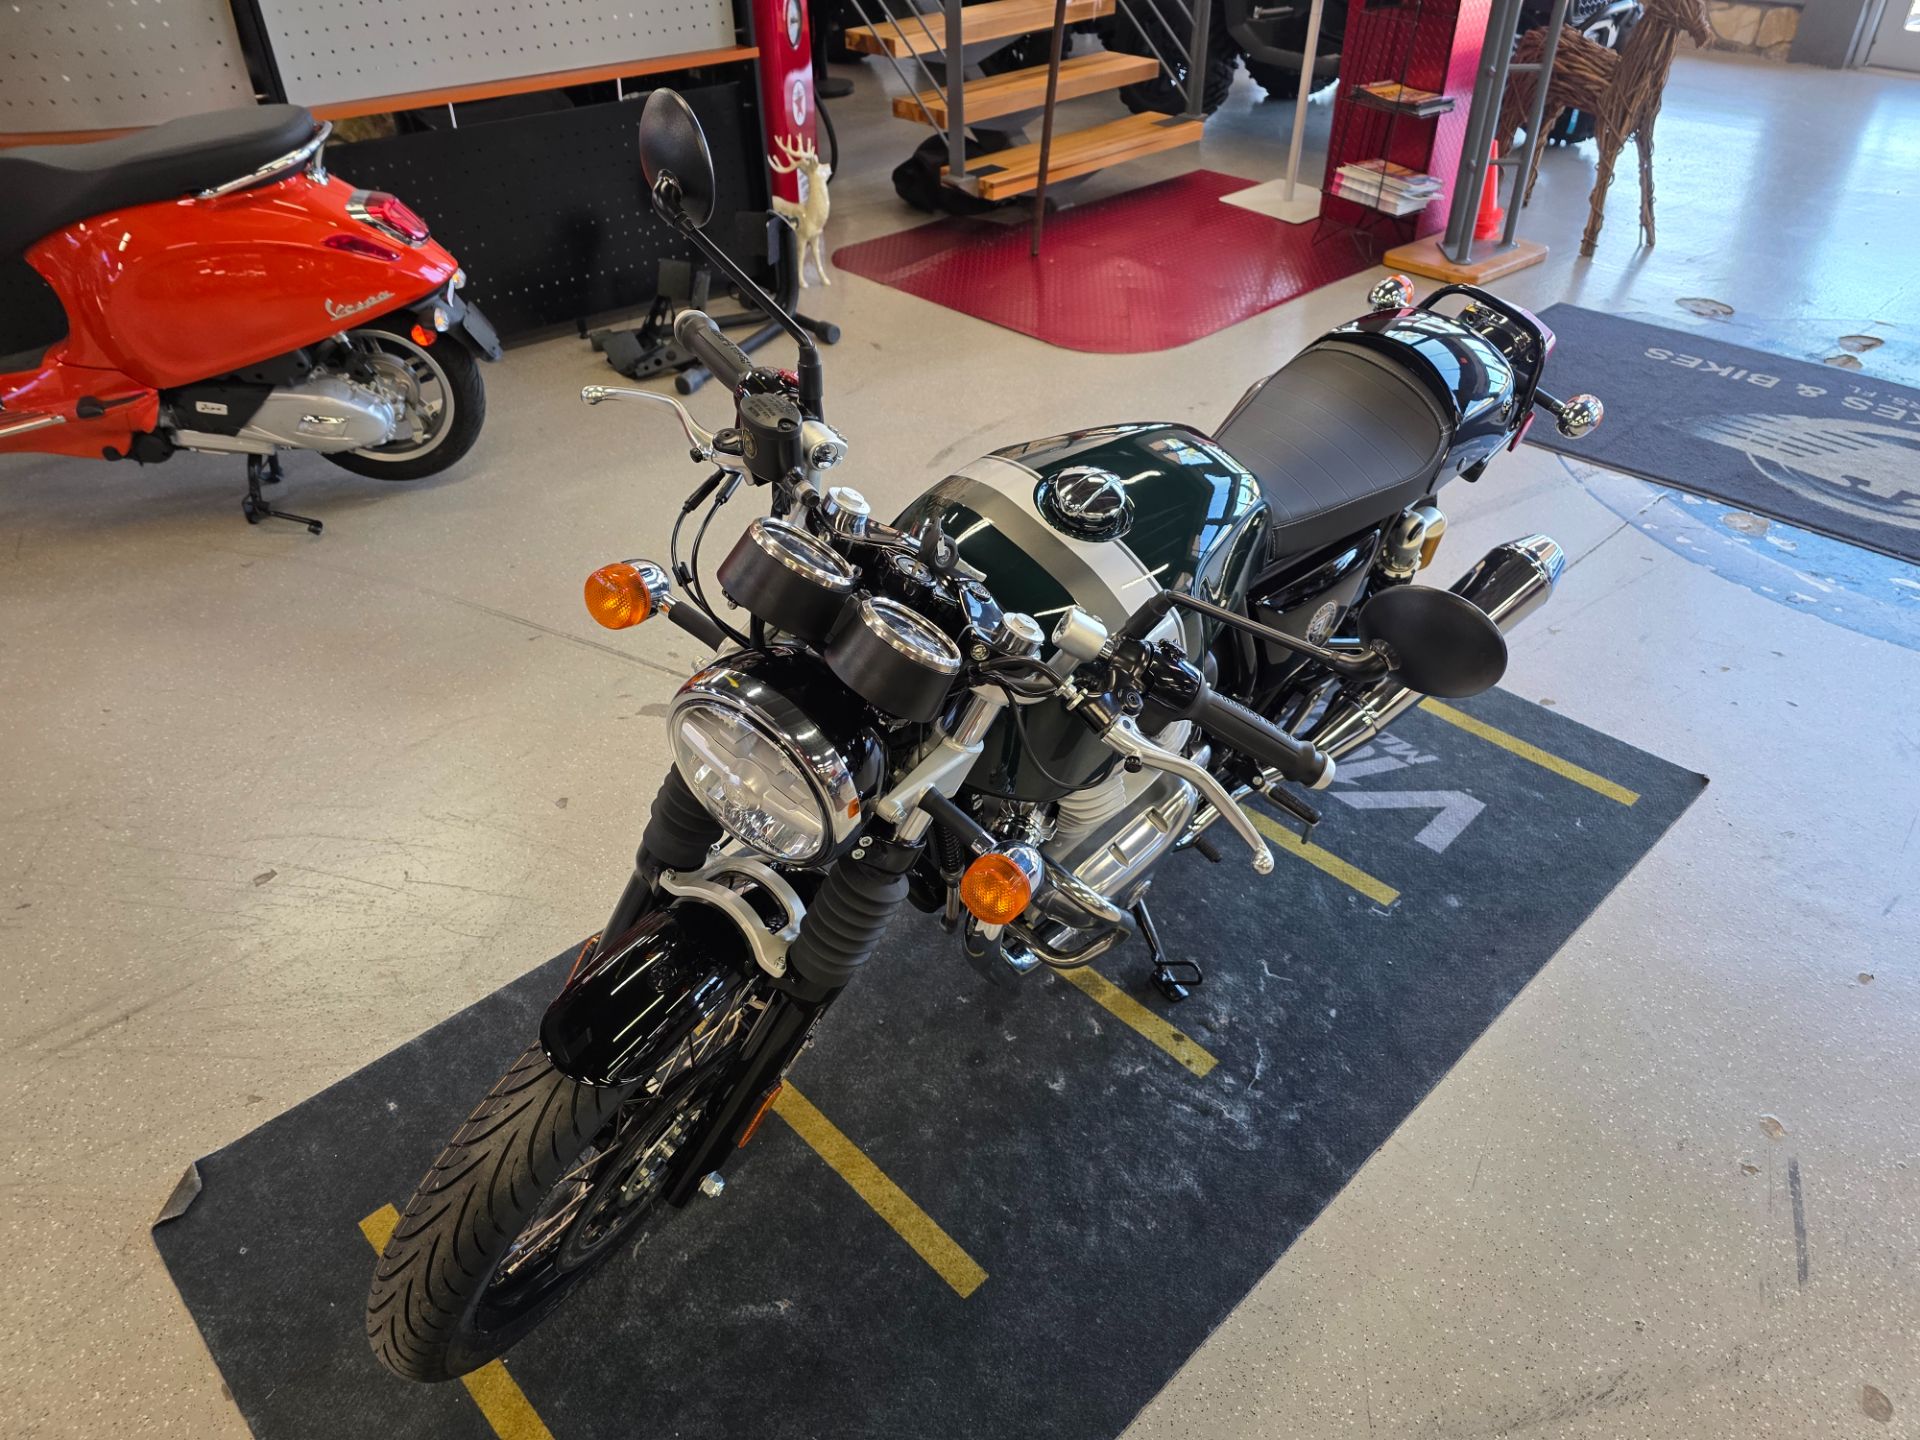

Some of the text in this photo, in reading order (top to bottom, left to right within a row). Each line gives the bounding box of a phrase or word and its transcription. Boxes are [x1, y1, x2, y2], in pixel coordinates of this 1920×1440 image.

[324, 290, 396, 321] Vespa
[1643, 347, 1781, 389] BIKES
[1795, 383, 1828, 398] &
